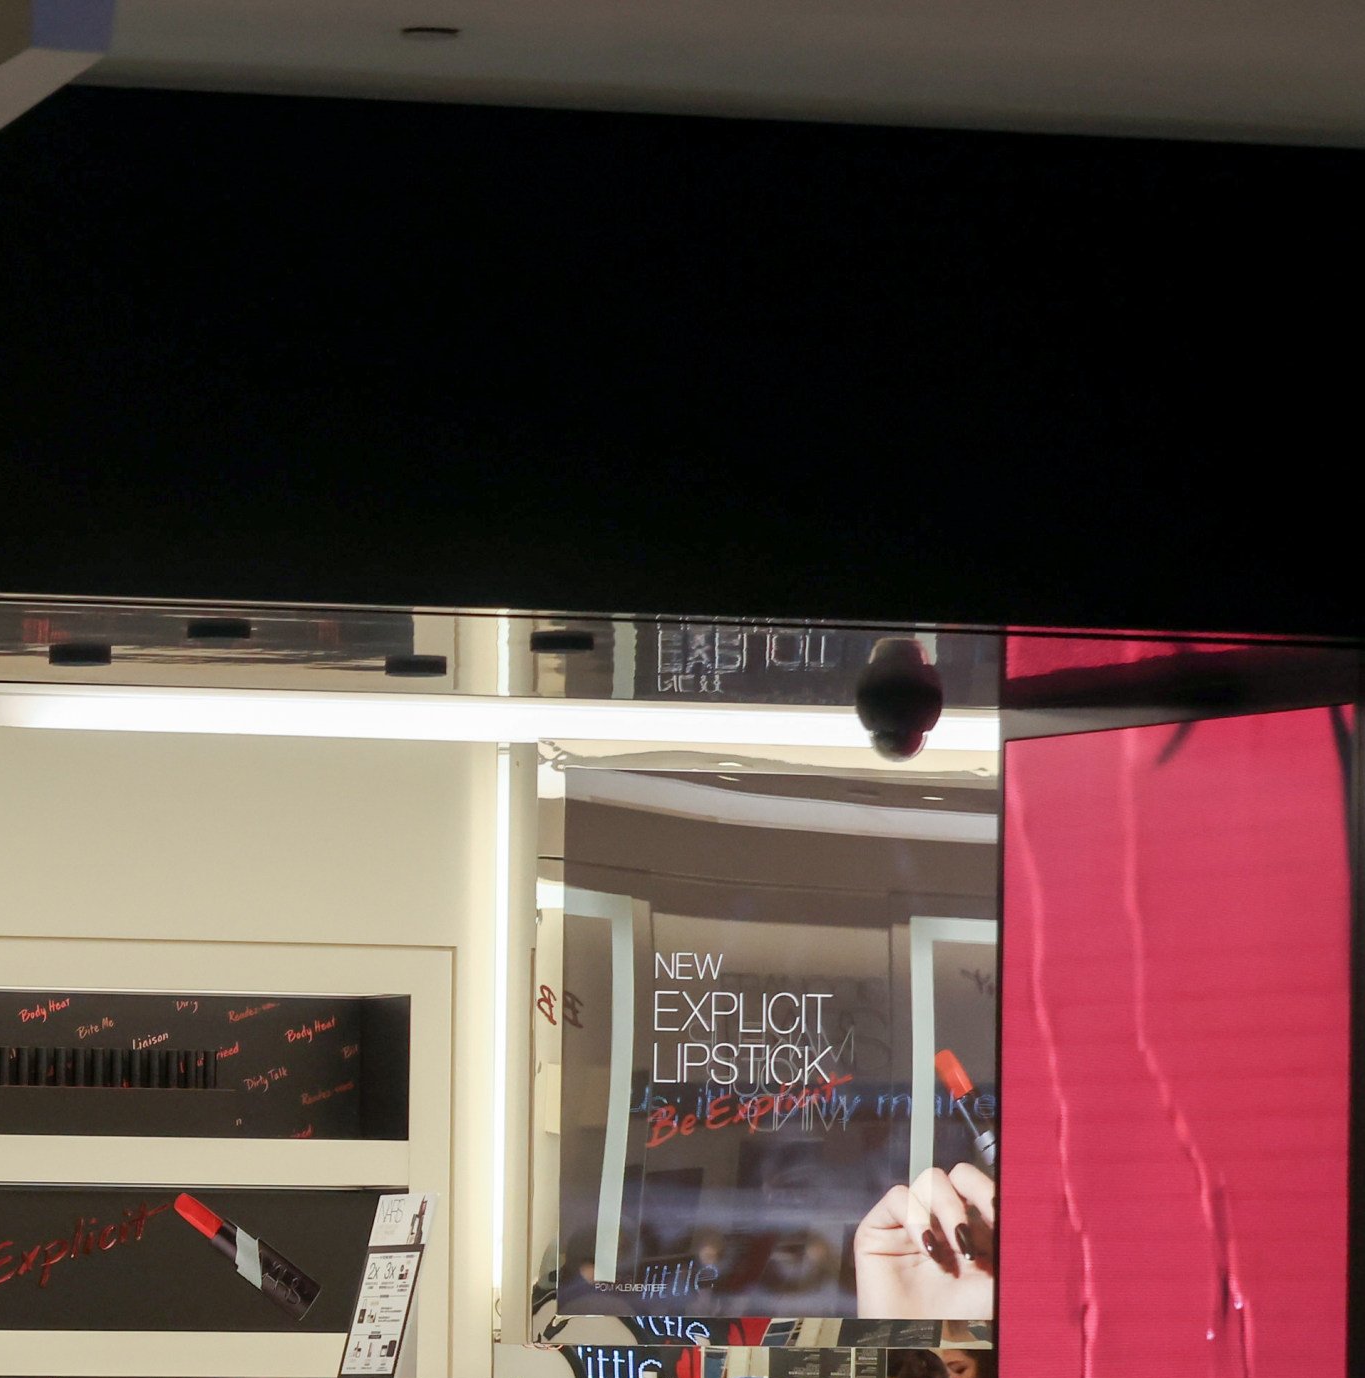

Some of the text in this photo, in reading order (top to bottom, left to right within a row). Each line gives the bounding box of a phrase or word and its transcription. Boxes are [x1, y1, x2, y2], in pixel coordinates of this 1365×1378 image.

[654, 951, 724, 981] NEW
[18, 1006, 47, 1024] Body
[284, 1015, 338, 1044] Body Heat
[653, 991, 834, 1034] EXPLICIT
[132, 1031, 170, 1050] Liaison
[652, 1042, 833, 1086] LIPSTICK
[645, 1104, 696, 1149] Be
[640, 1260, 719, 1300] little
